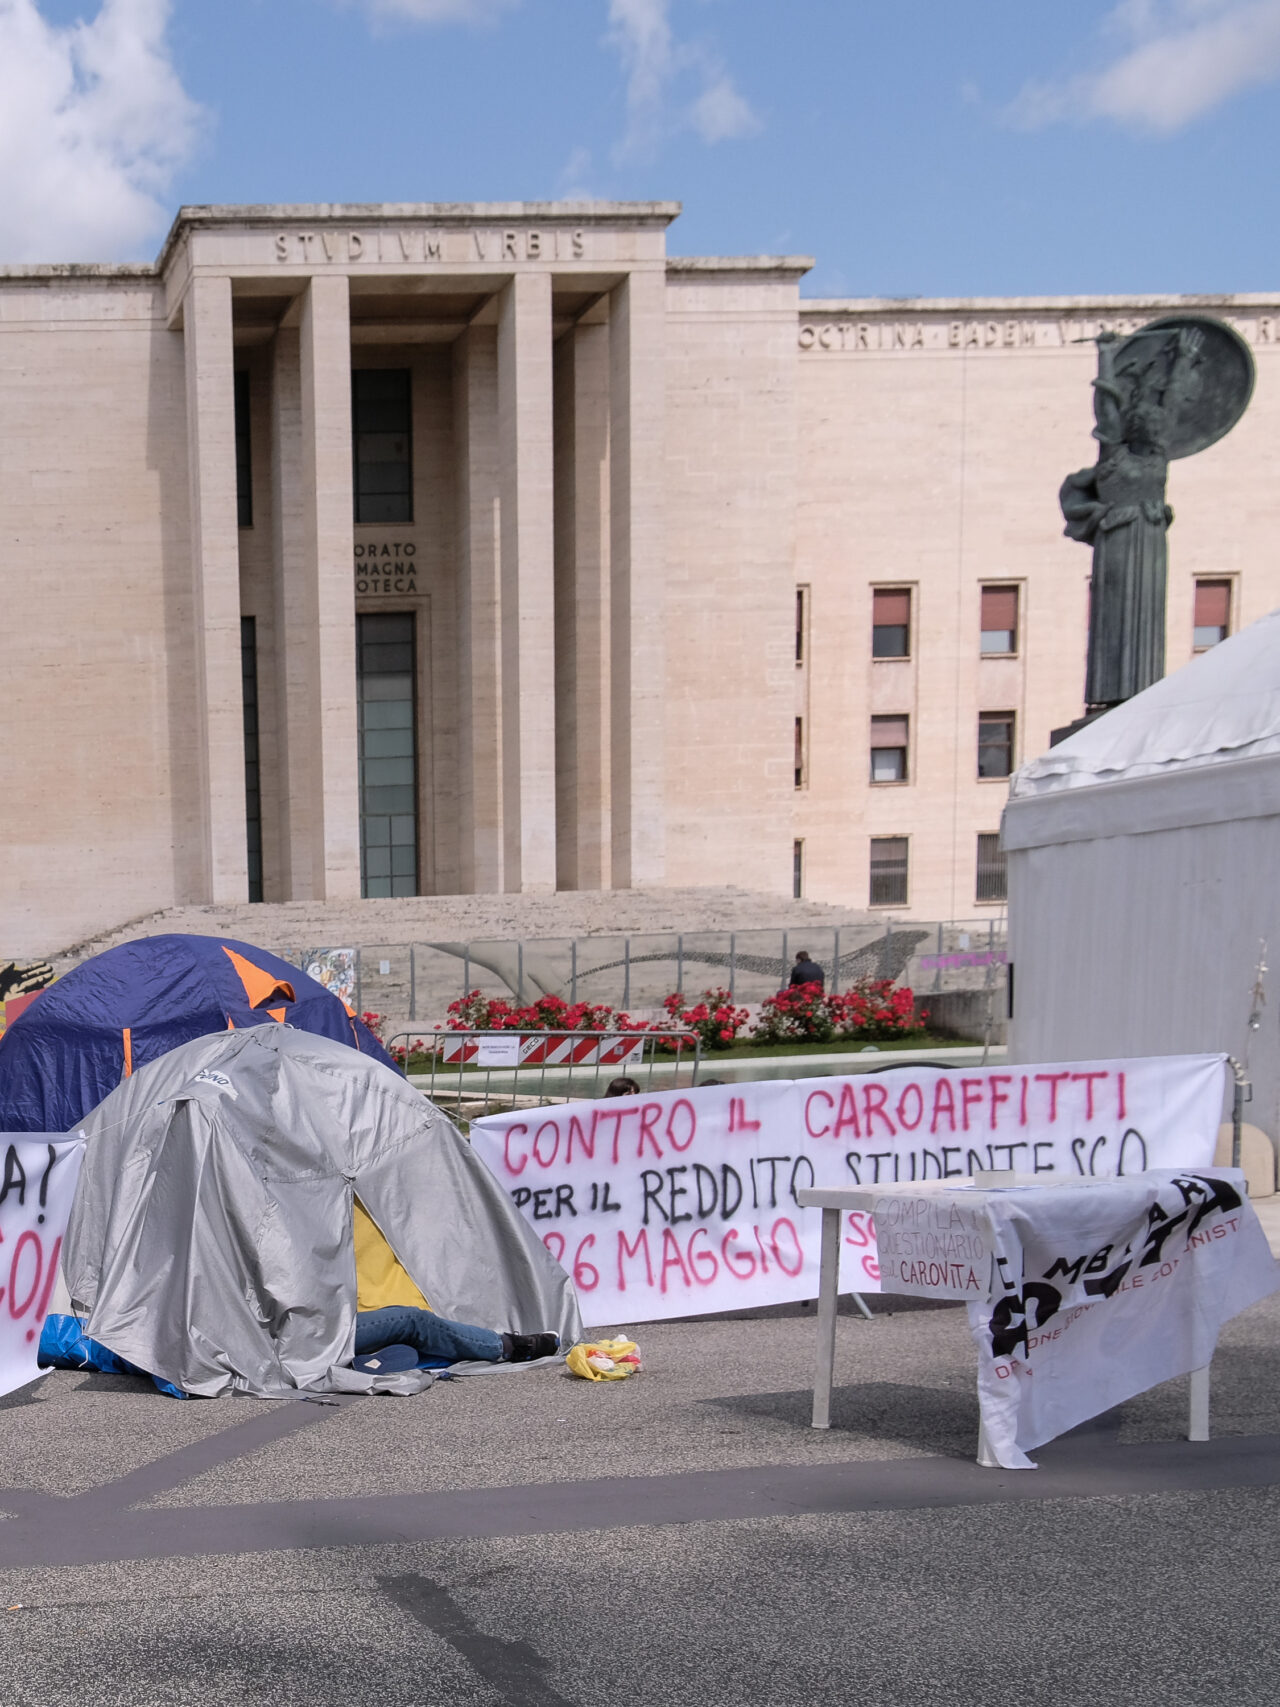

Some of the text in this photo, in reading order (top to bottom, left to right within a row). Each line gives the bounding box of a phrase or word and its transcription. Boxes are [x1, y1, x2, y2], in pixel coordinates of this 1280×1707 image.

[475, 228, 585, 259] VRBIS
[948, 320, 1037, 347] EADEM
[354, 543, 417, 557] ORATO
[357, 562, 417, 575] MAGNA
[357, 579, 417, 592] OTECA
[505, 1072, 1126, 1176] CONTRO IL CAROAFFITTI
[511, 1183, 577, 1220] PER
[590, 1182, 622, 1212] IL
[640, 1155, 815, 1226] REDDITO
[874, 1198, 965, 1231] COMPILA
[617, 1217, 804, 1294] MAGGIO
[879, 1230, 984, 1260] QUESTIONARIO
[900, 1260, 982, 1291] CAROVITA
